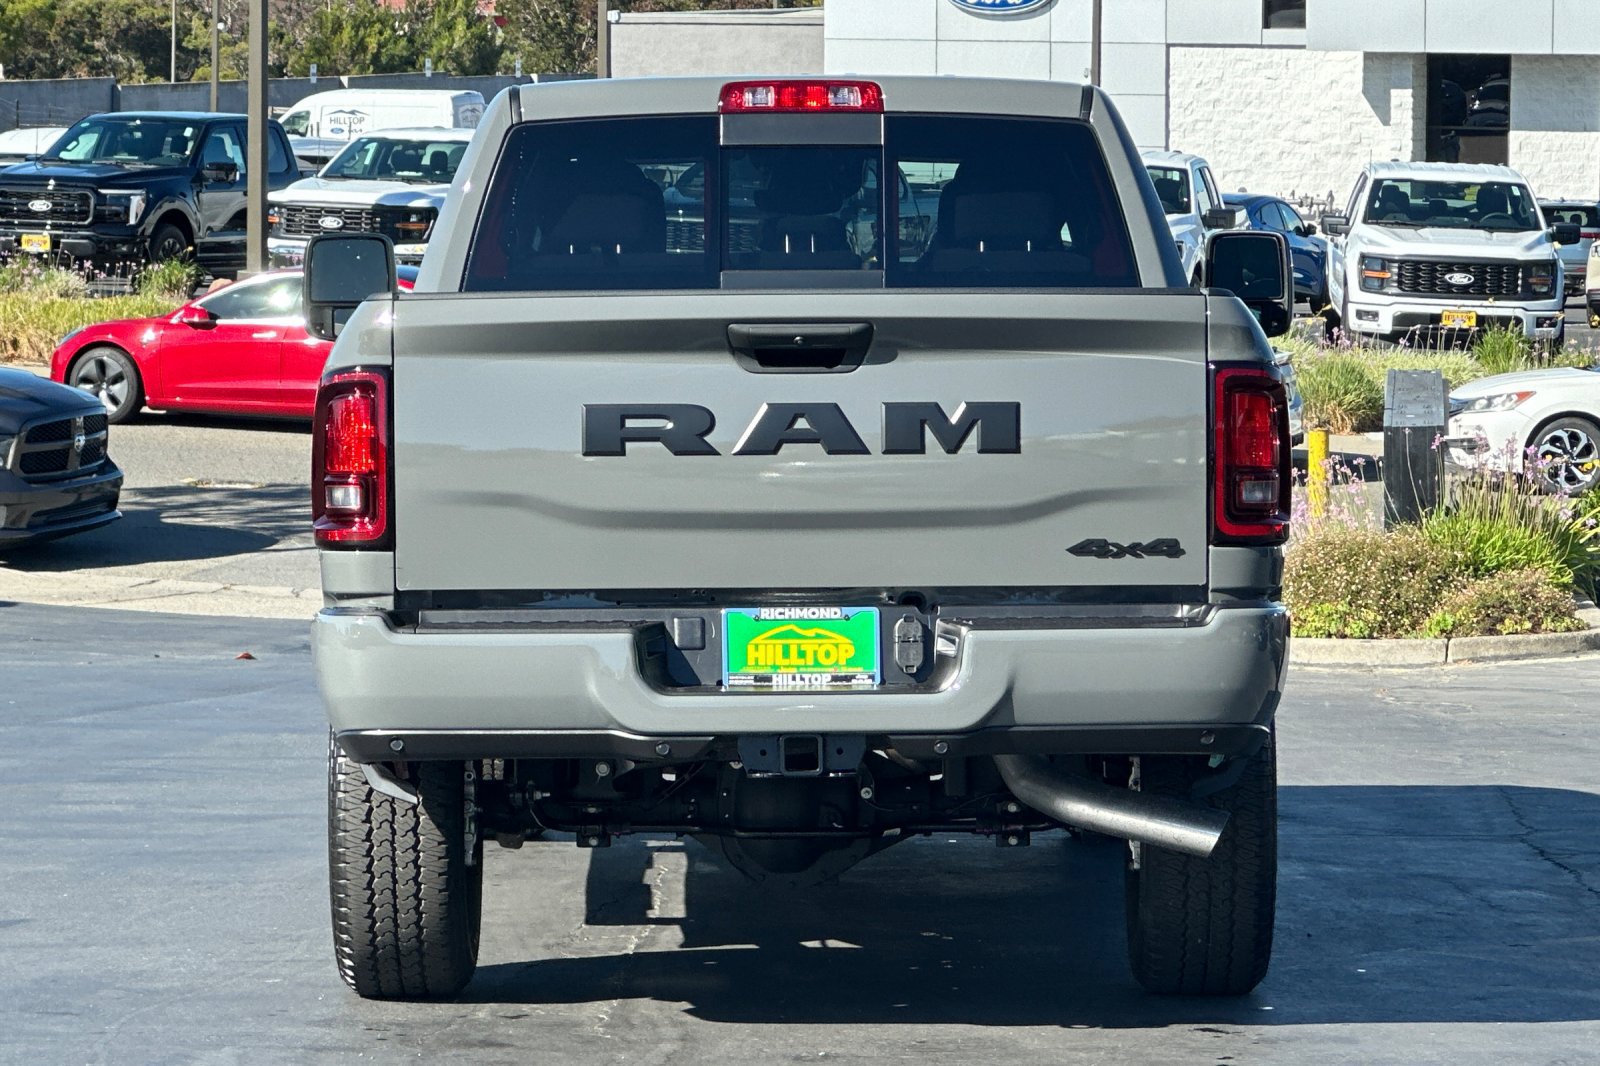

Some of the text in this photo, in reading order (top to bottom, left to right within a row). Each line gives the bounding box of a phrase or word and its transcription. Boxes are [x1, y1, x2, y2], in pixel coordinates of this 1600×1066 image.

[329, 116, 365, 125] HILLTOP
[582, 402, 1021, 456] RAM
[1065, 538, 1186, 559] 4x4
[760, 607, 842, 620] RICHMOND
[747, 643, 855, 666] HILLTOP
[771, 673, 832, 685] HILLTOP
